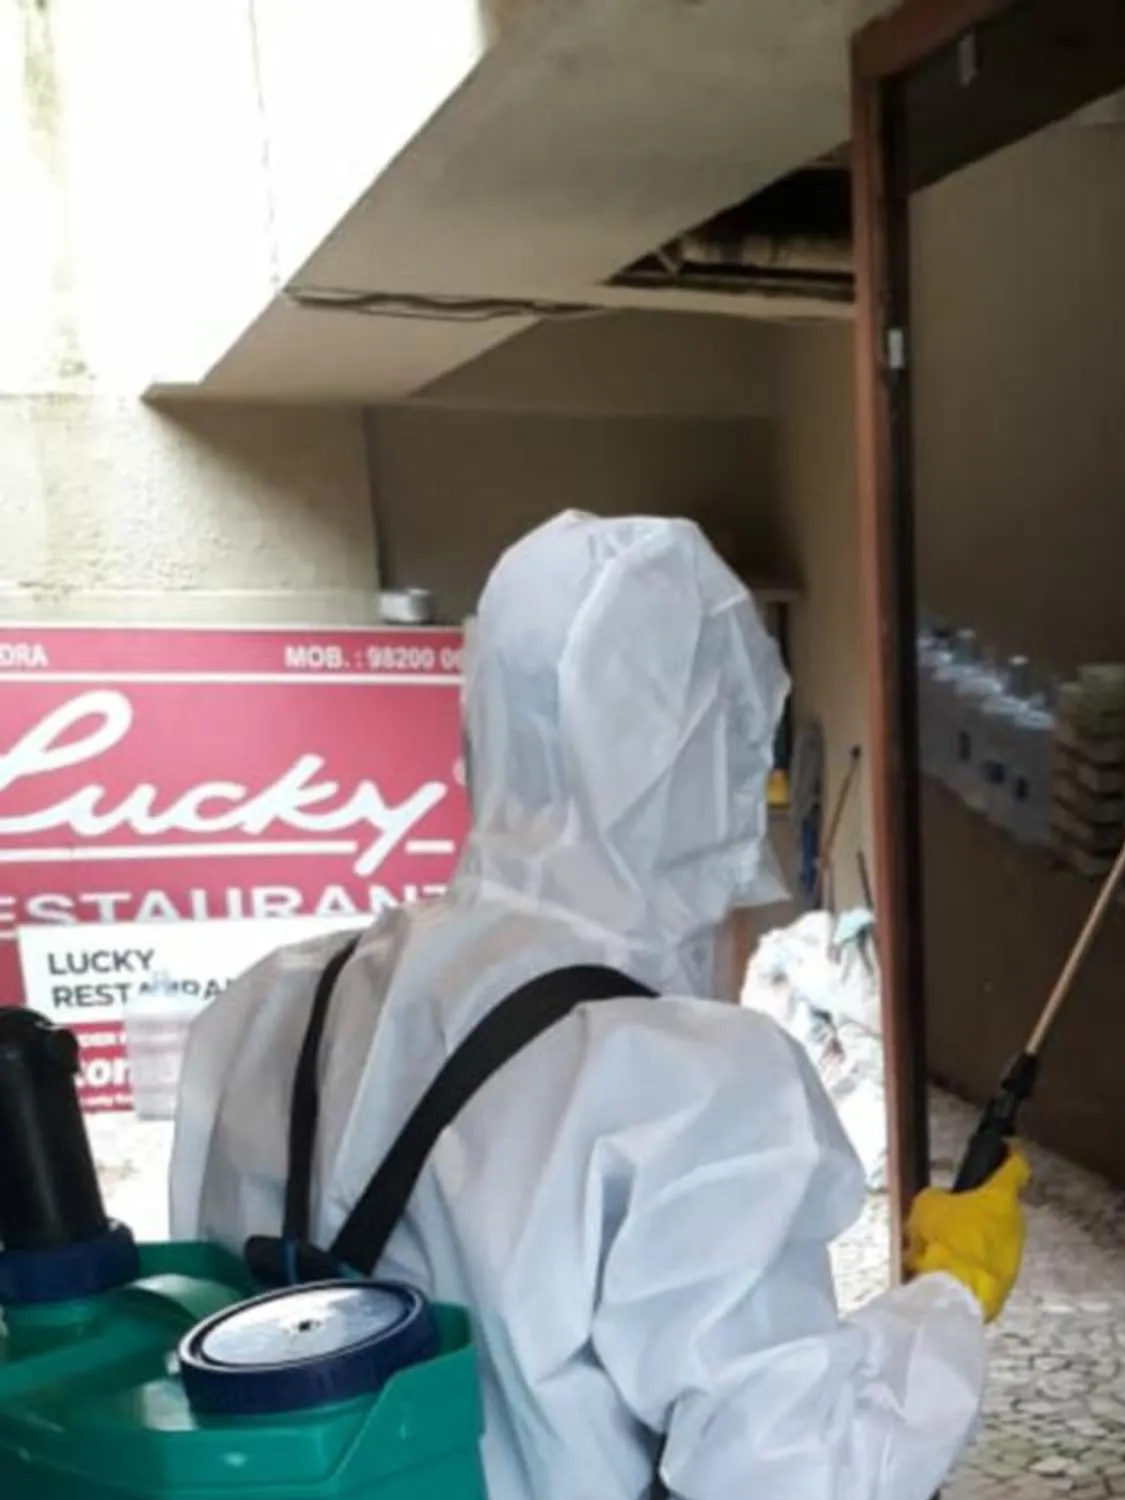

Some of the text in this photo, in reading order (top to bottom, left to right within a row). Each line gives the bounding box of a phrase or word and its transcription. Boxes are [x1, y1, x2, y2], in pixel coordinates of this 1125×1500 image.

[0, 690, 447, 876] Lucky
[0, 884, 448, 931] STAURAN
[48, 948, 155, 975] LUCKY
